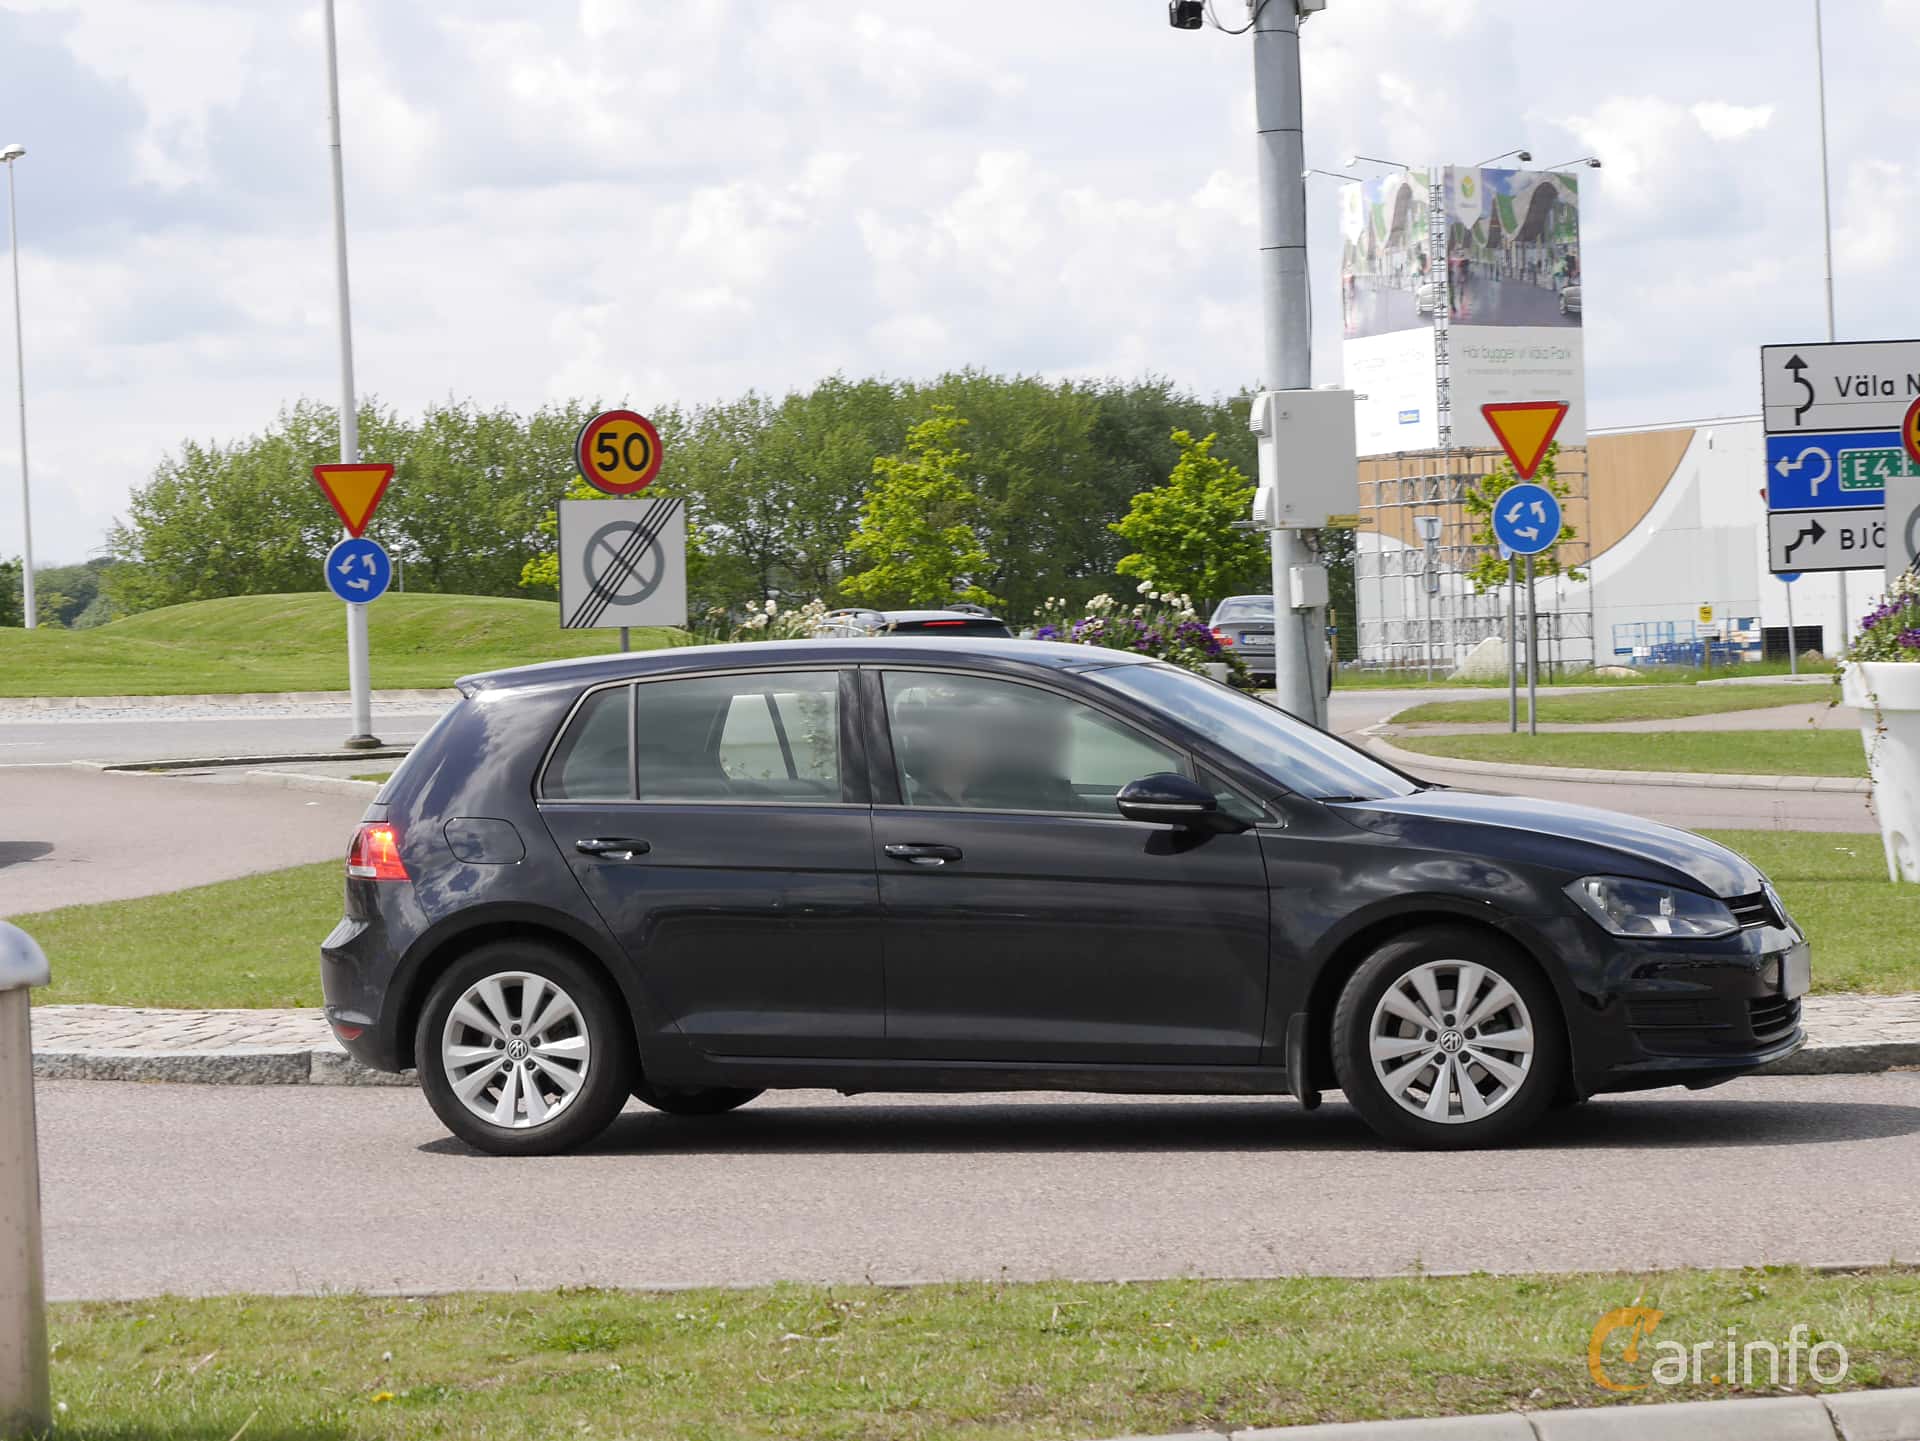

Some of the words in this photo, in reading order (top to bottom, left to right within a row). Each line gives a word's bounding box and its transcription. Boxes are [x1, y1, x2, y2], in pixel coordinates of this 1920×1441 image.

[1834, 374, 1895, 397] Väla
[597, 432, 649, 472] 50
[1854, 457, 1891, 481] E4
